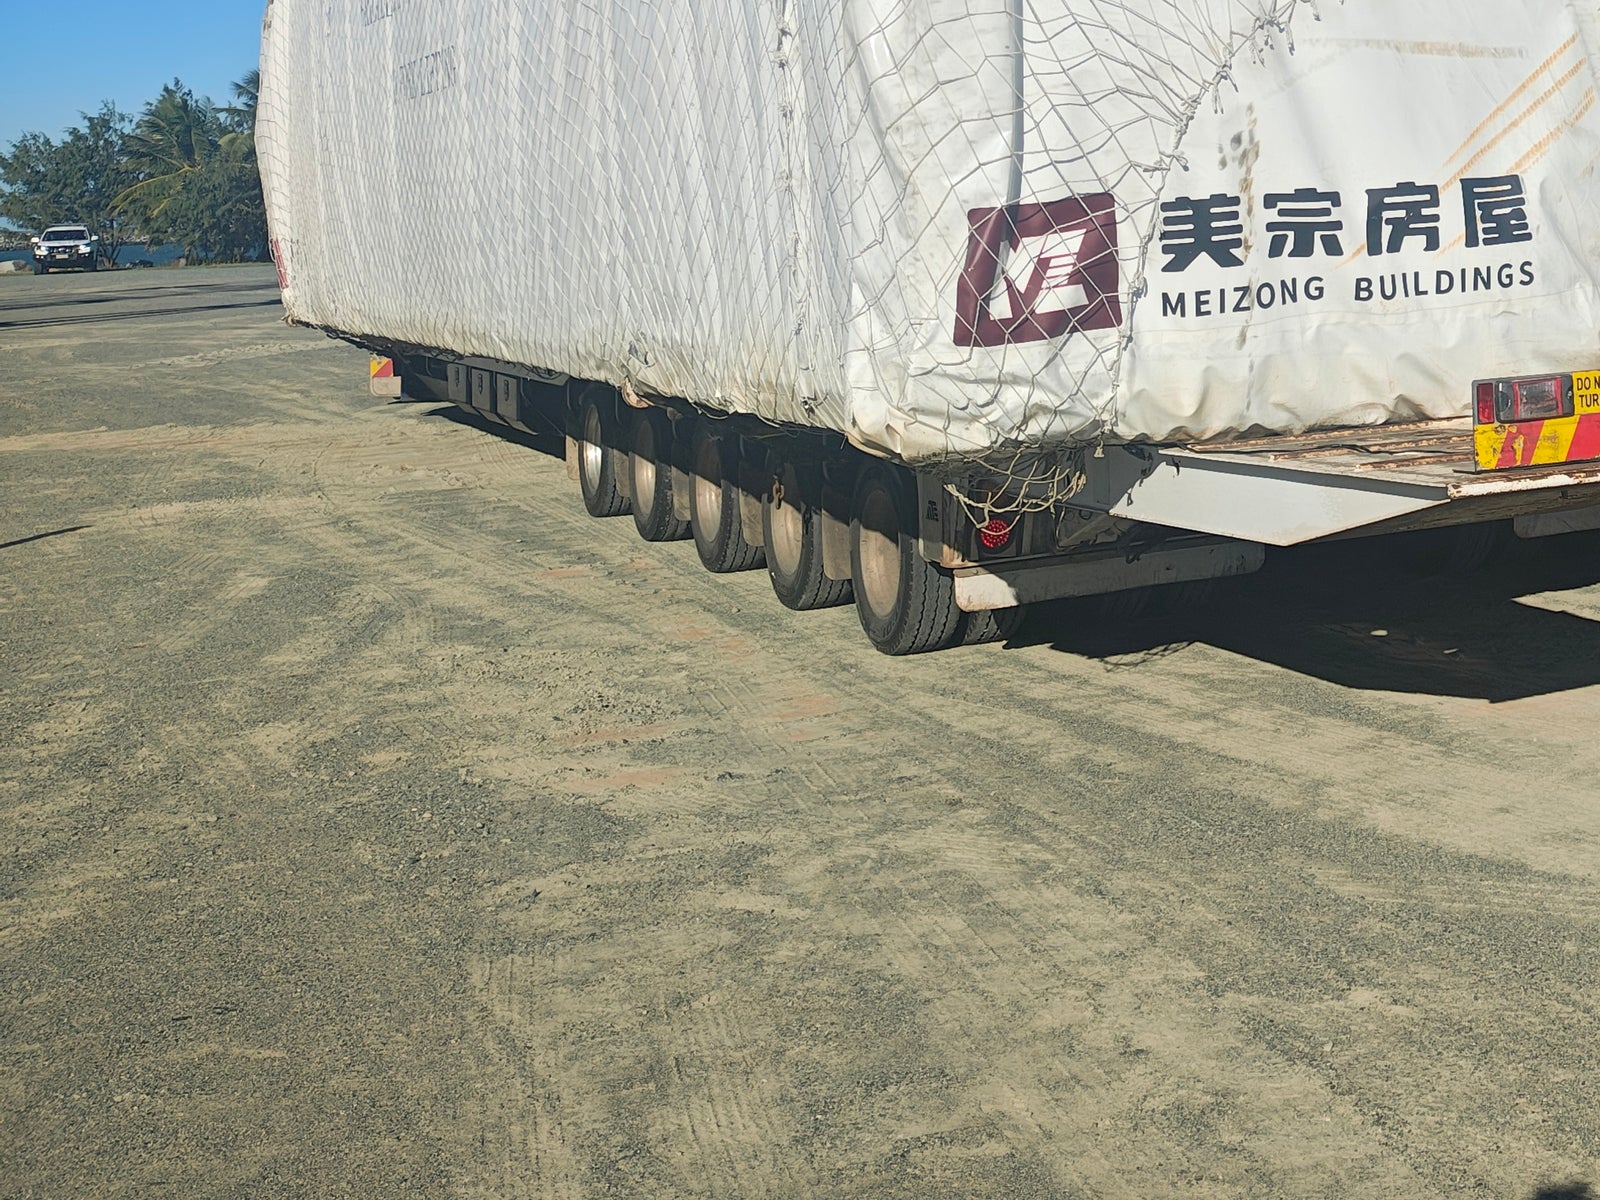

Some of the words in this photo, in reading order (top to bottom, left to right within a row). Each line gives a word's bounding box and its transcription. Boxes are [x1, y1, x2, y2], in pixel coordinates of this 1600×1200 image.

[1160, 174, 1532, 272] 美宗房屋
[1161, 276, 1325, 317] MEIZONG
[1354, 261, 1534, 301] BUILDINGS
[1576, 377, 1591, 391] DO
